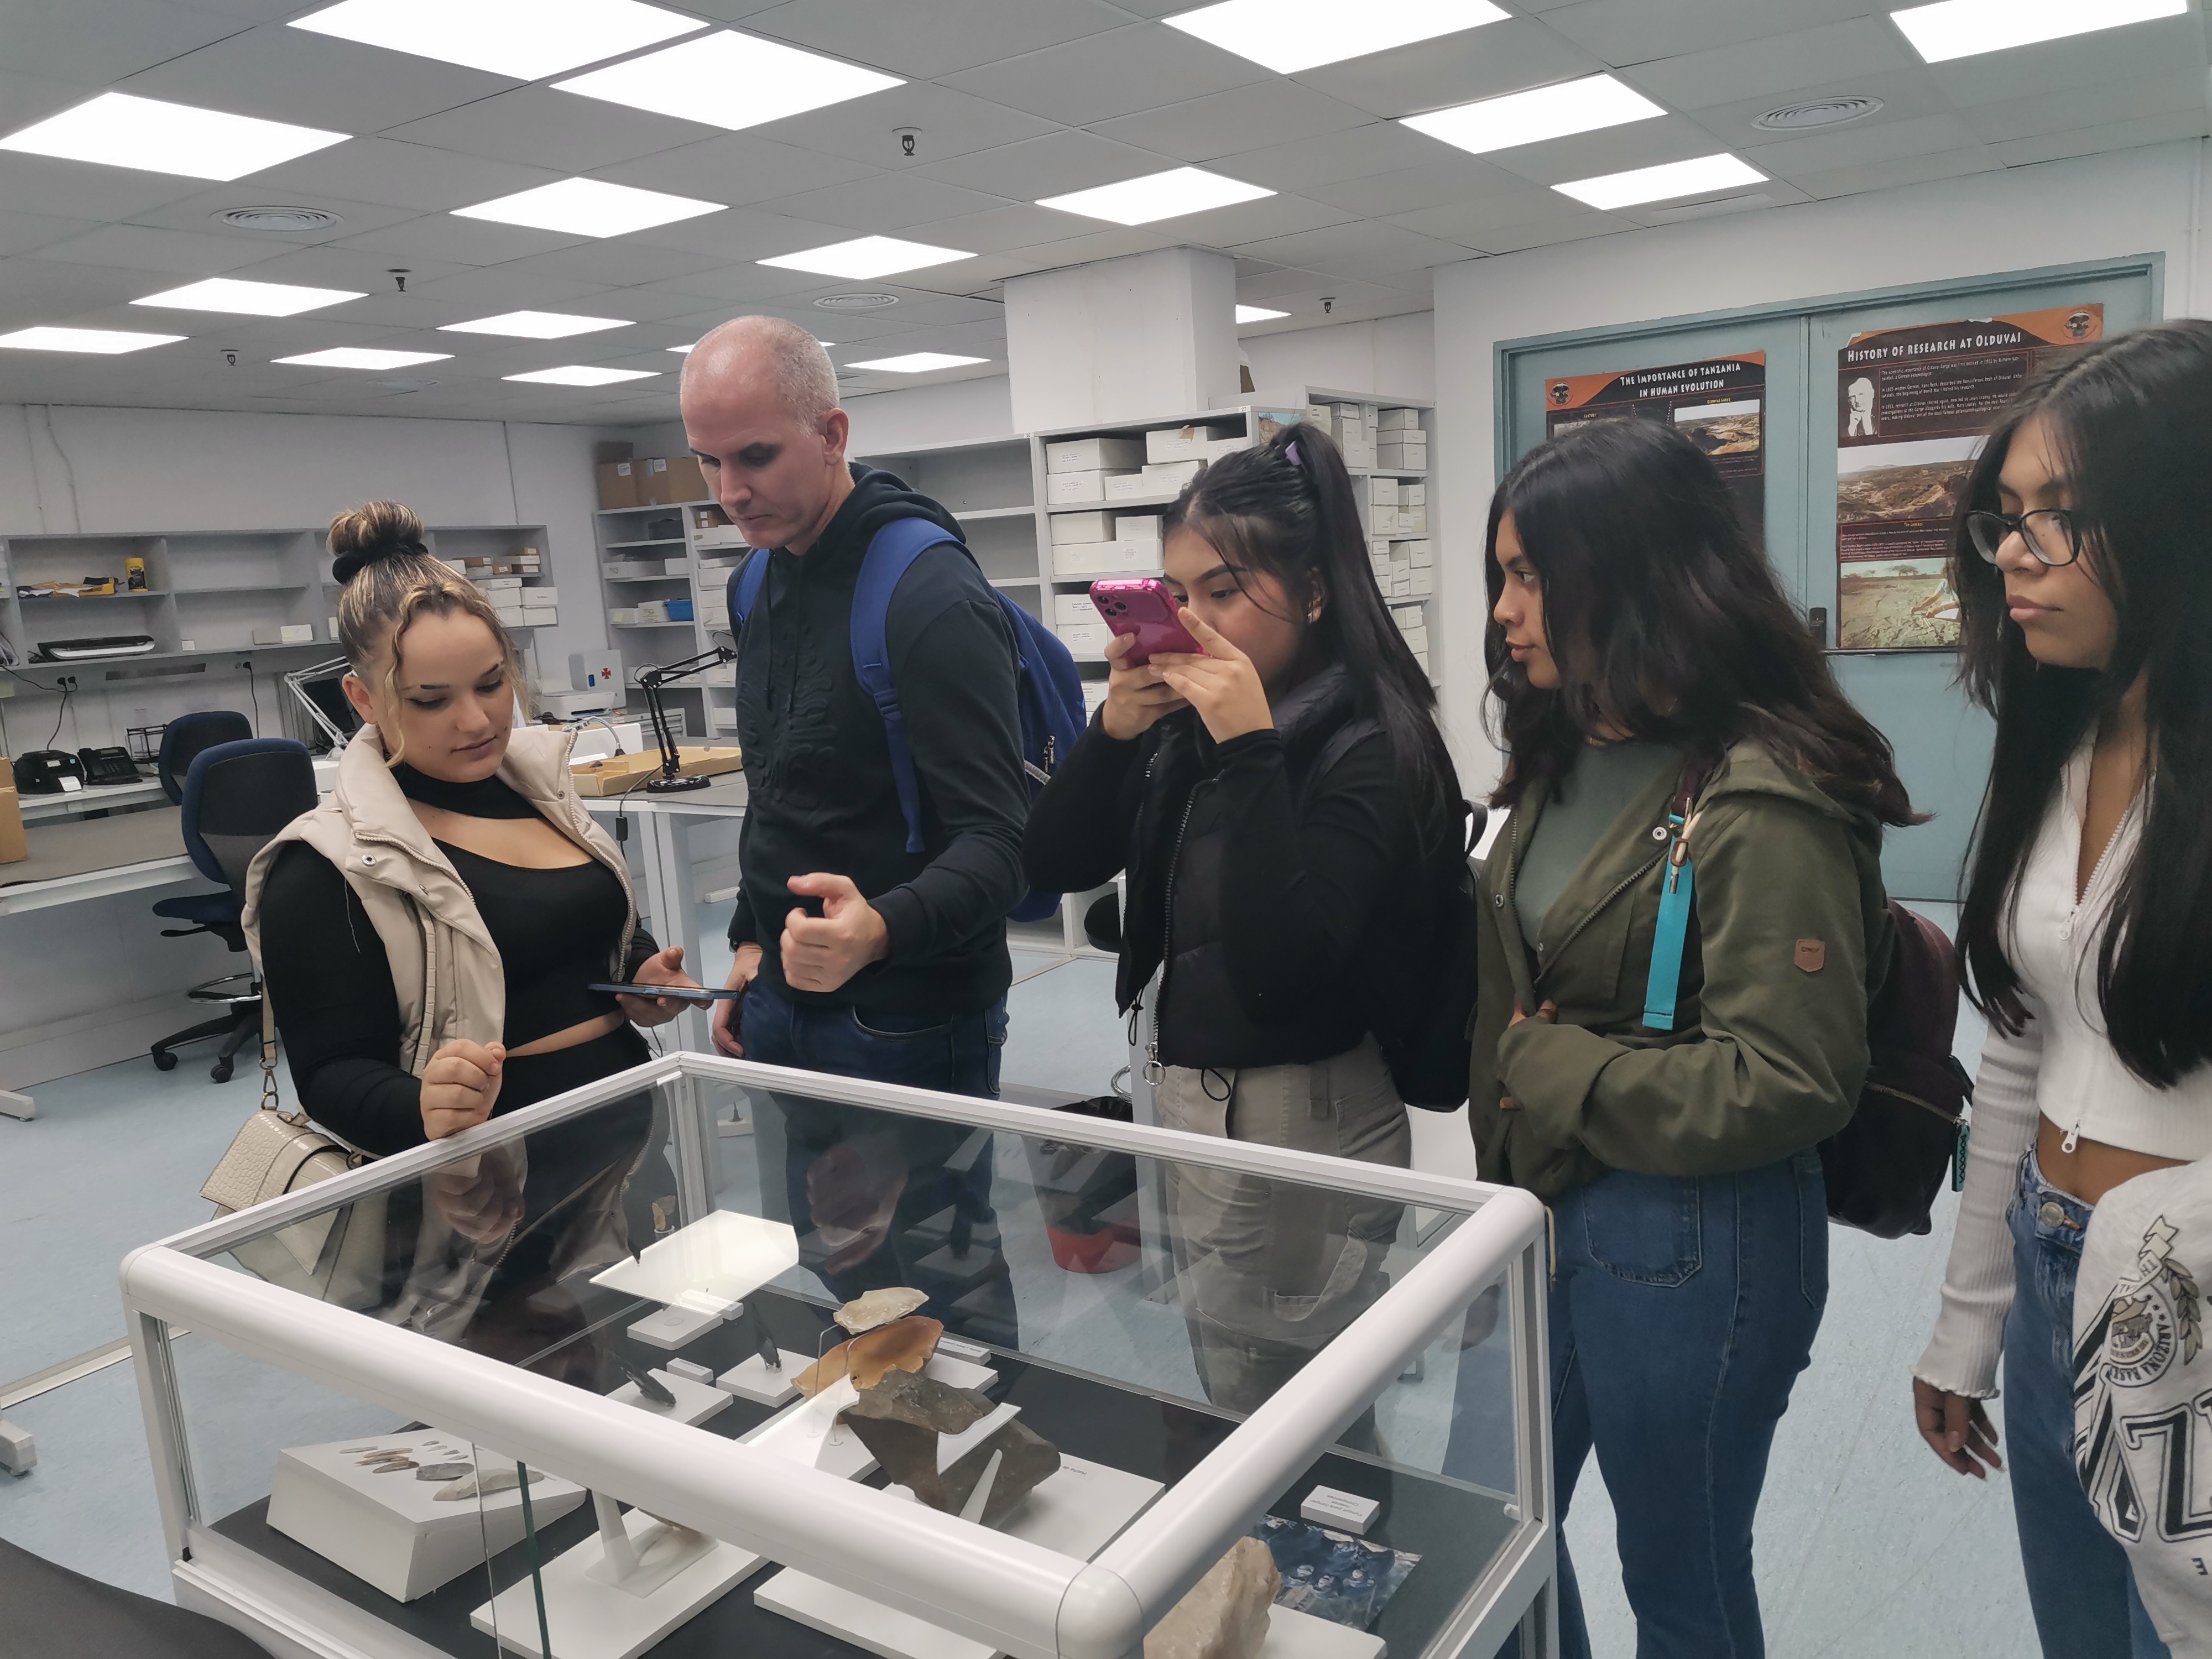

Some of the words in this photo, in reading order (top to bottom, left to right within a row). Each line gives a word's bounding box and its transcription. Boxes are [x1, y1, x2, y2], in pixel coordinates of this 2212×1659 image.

[1848, 347, 1888, 362] HISTORY
[1892, 346, 1903, 356] OF
[1907, 340, 1955, 355] RESEARCH
[1959, 338, 1972, 349] AT
[1976, 332, 2021, 347] OLDUVAI
[1620, 376, 1635, 387] THE
[1637, 369, 1686, 384] IMPORTANCE
[1688, 368, 1698, 377] OF
[1700, 362, 1741, 377] TANZANIA
[1640, 389, 1648, 398] IN
[1651, 385, 1678, 397] HUMAN
[1681, 379, 1724, 393] EVOLUTION
